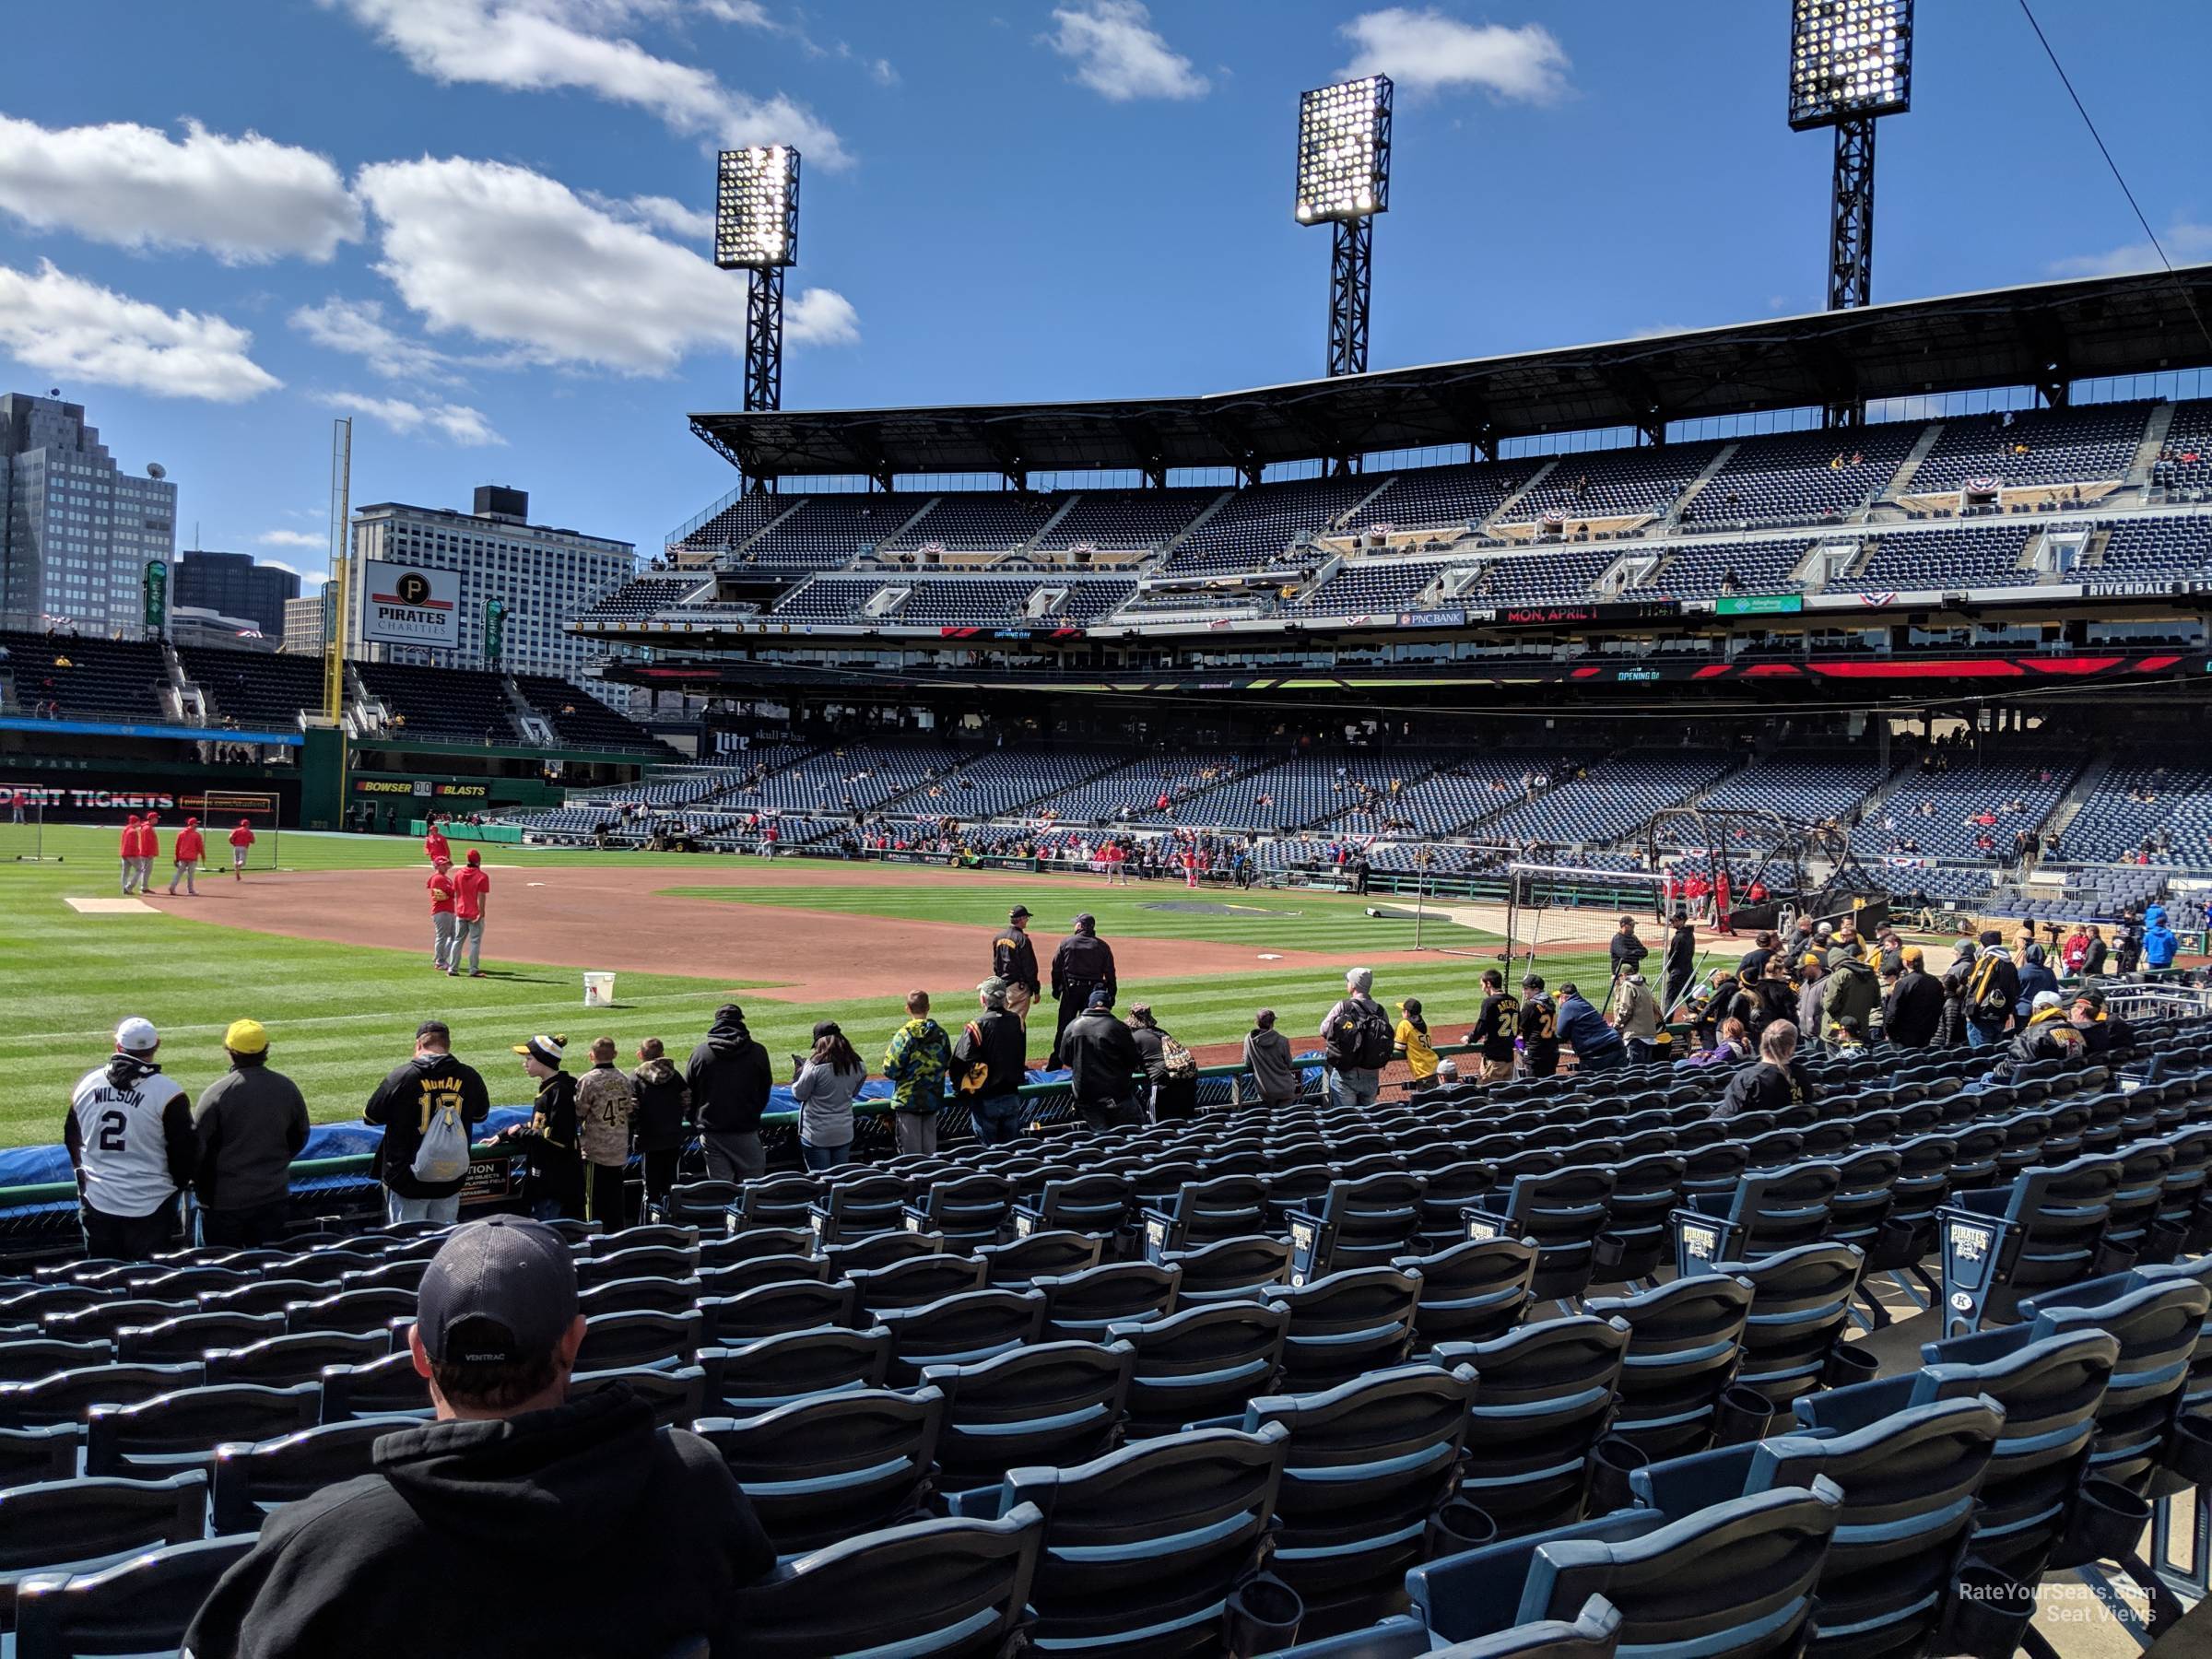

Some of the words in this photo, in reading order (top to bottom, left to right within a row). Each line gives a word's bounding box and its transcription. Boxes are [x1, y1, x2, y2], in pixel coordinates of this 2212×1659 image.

[406, 580, 422, 599] P
[2089, 582, 2173, 595] RIVENDALE
[379, 606, 446, 625] PIRATES
[1412, 615, 1433, 624] PNC
[1433, 613, 1461, 623] BANK
[1508, 610, 1544, 621] MON,
[1548, 608, 1587, 620] APRIL
[378, 620, 446, 635] CHARITIES
[1618, 672, 1650, 680] OPENING
[756, 729, 778, 740] skull
[715, 732, 750, 754] Lite
[35, 759, 88, 769] PARK
[365, 782, 412, 793] BOWSER
[443, 785, 486, 795] BLASTS
[69, 790, 174, 808] TICKETS
[94, 1087, 146, 1109] WILSON
[100, 1110, 127, 1151] 2
[468, 1164, 495, 1175] TION
[1951, 1224, 1989, 1251] PIRATES
[1957, 1295, 1967, 1307] K
[465, 1353, 505, 1361] VENTRAC
